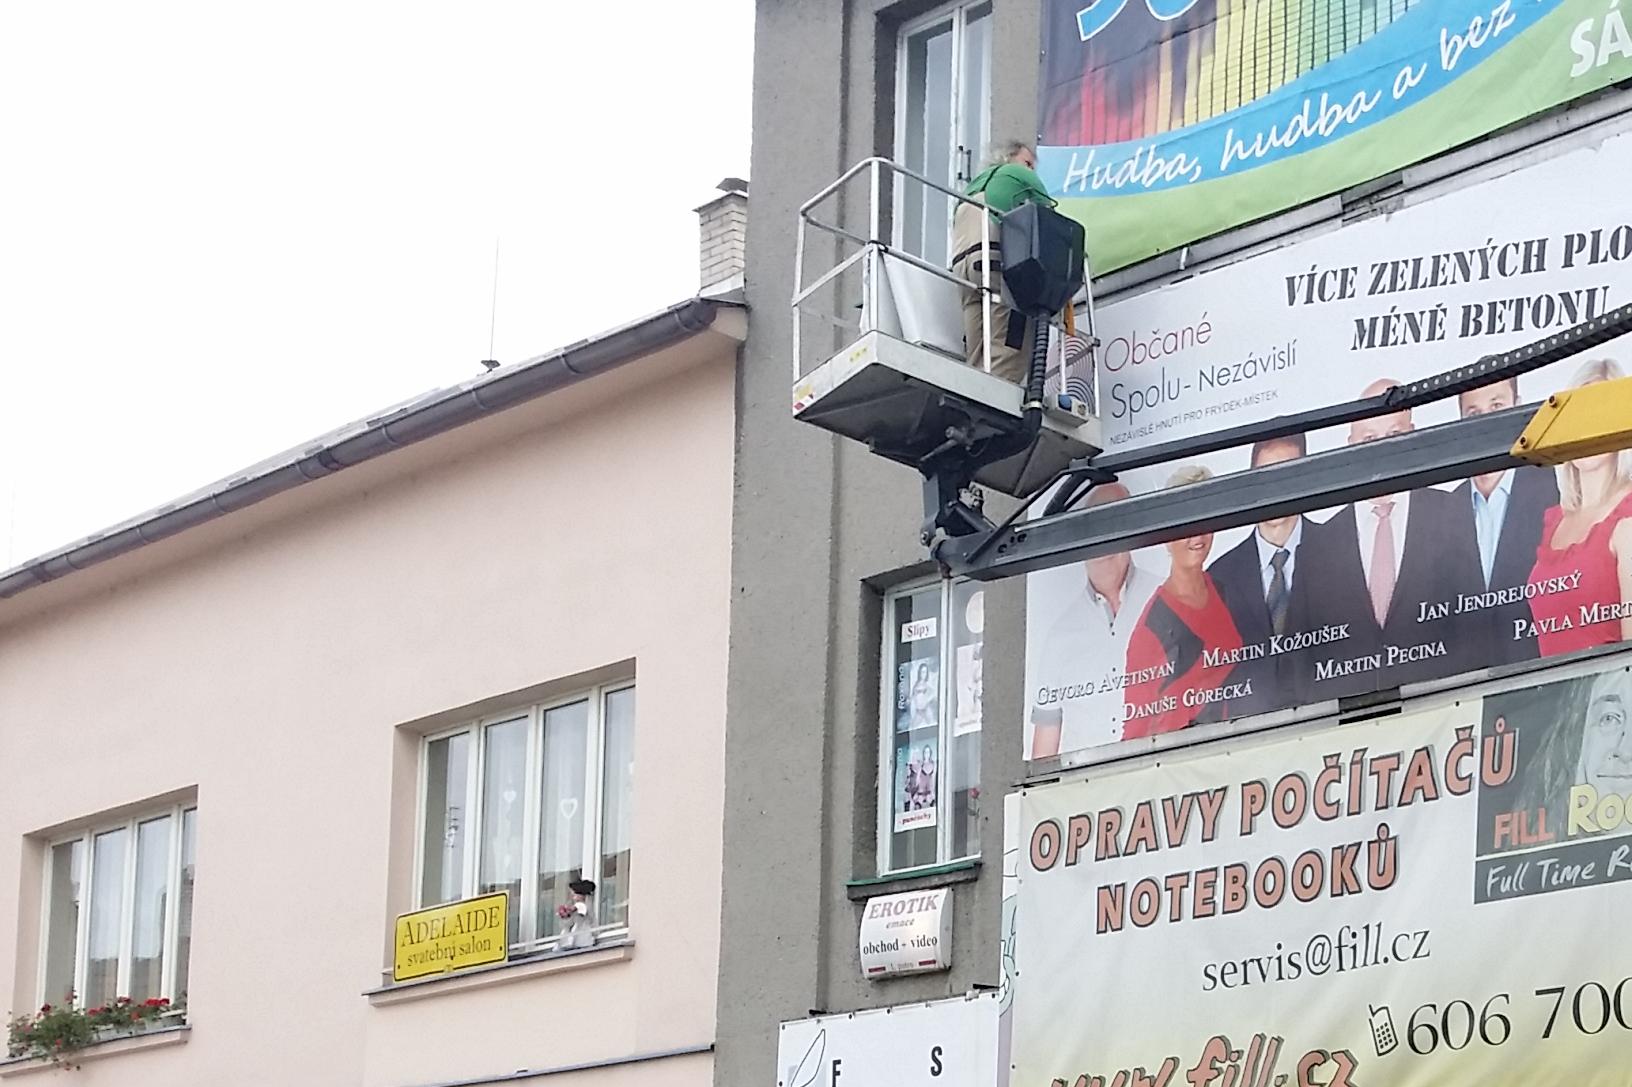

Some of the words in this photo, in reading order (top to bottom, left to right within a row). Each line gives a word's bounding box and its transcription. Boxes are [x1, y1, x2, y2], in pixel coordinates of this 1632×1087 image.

[1063, 145, 1201, 192] Hudba,
[1220, 91, 1383, 170] hudba
[1392, 62, 1428, 99] a
[1440, 3, 1516, 71] bez
[1285, 264, 1358, 306] VÍCE
[1367, 238, 1549, 296] ZELENÝCH
[1458, 285, 1610, 338] BETONU
[1104, 311, 1212, 372] Občané
[1199, 338, 1298, 392] Nezávislí
[1183, 409, 1203, 424] PRO
[1029, 786, 1228, 872] OPRAVY
[1239, 717, 1519, 836] POČÍTAČŮ
[1493, 807, 1555, 849] FILL
[1096, 822, 1399, 935] NOTEBOOKŮ
[1486, 861, 1526, 898] Full
[1537, 857, 1596, 887] Time
[401, 905, 501, 948] ADELAIDE
[869, 894, 940, 920] EROTIK
[458, 936, 491, 958] salon
[863, 938, 899, 955] obchod
[910, 934, 938, 949] video
[1202, 921, 1431, 991] servis@fill.cz
[1406, 993, 1512, 1056] 606
[930, 1046, 943, 1077] S
